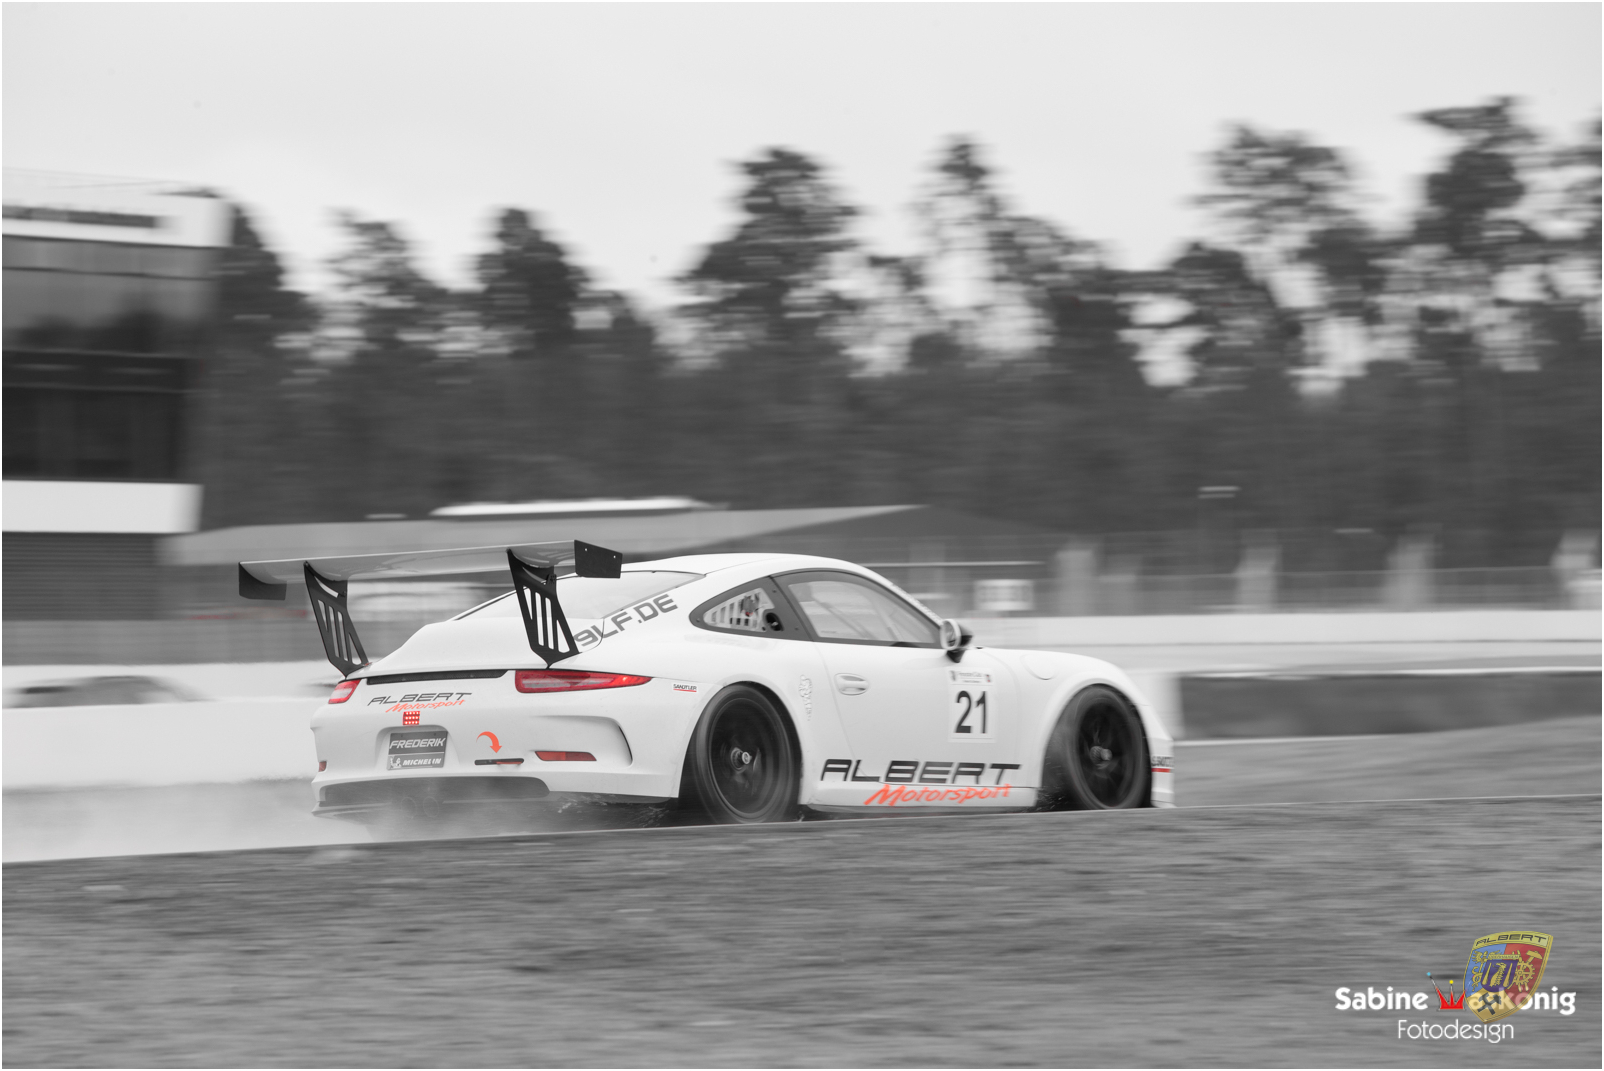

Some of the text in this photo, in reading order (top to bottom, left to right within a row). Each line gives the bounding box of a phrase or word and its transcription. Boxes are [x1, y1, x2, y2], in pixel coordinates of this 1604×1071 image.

[574, 594, 678, 647] 9LF.DE
[367, 692, 472, 706] ALBERT
[385, 699, 466, 713] Motorsport
[954, 690, 987, 734] 21
[389, 737, 446, 750] FREDERIK
[402, 758, 442, 766] MICHELIN
[820, 758, 1022, 785] ALBERT
[863, 783, 1012, 807] Motorsport
